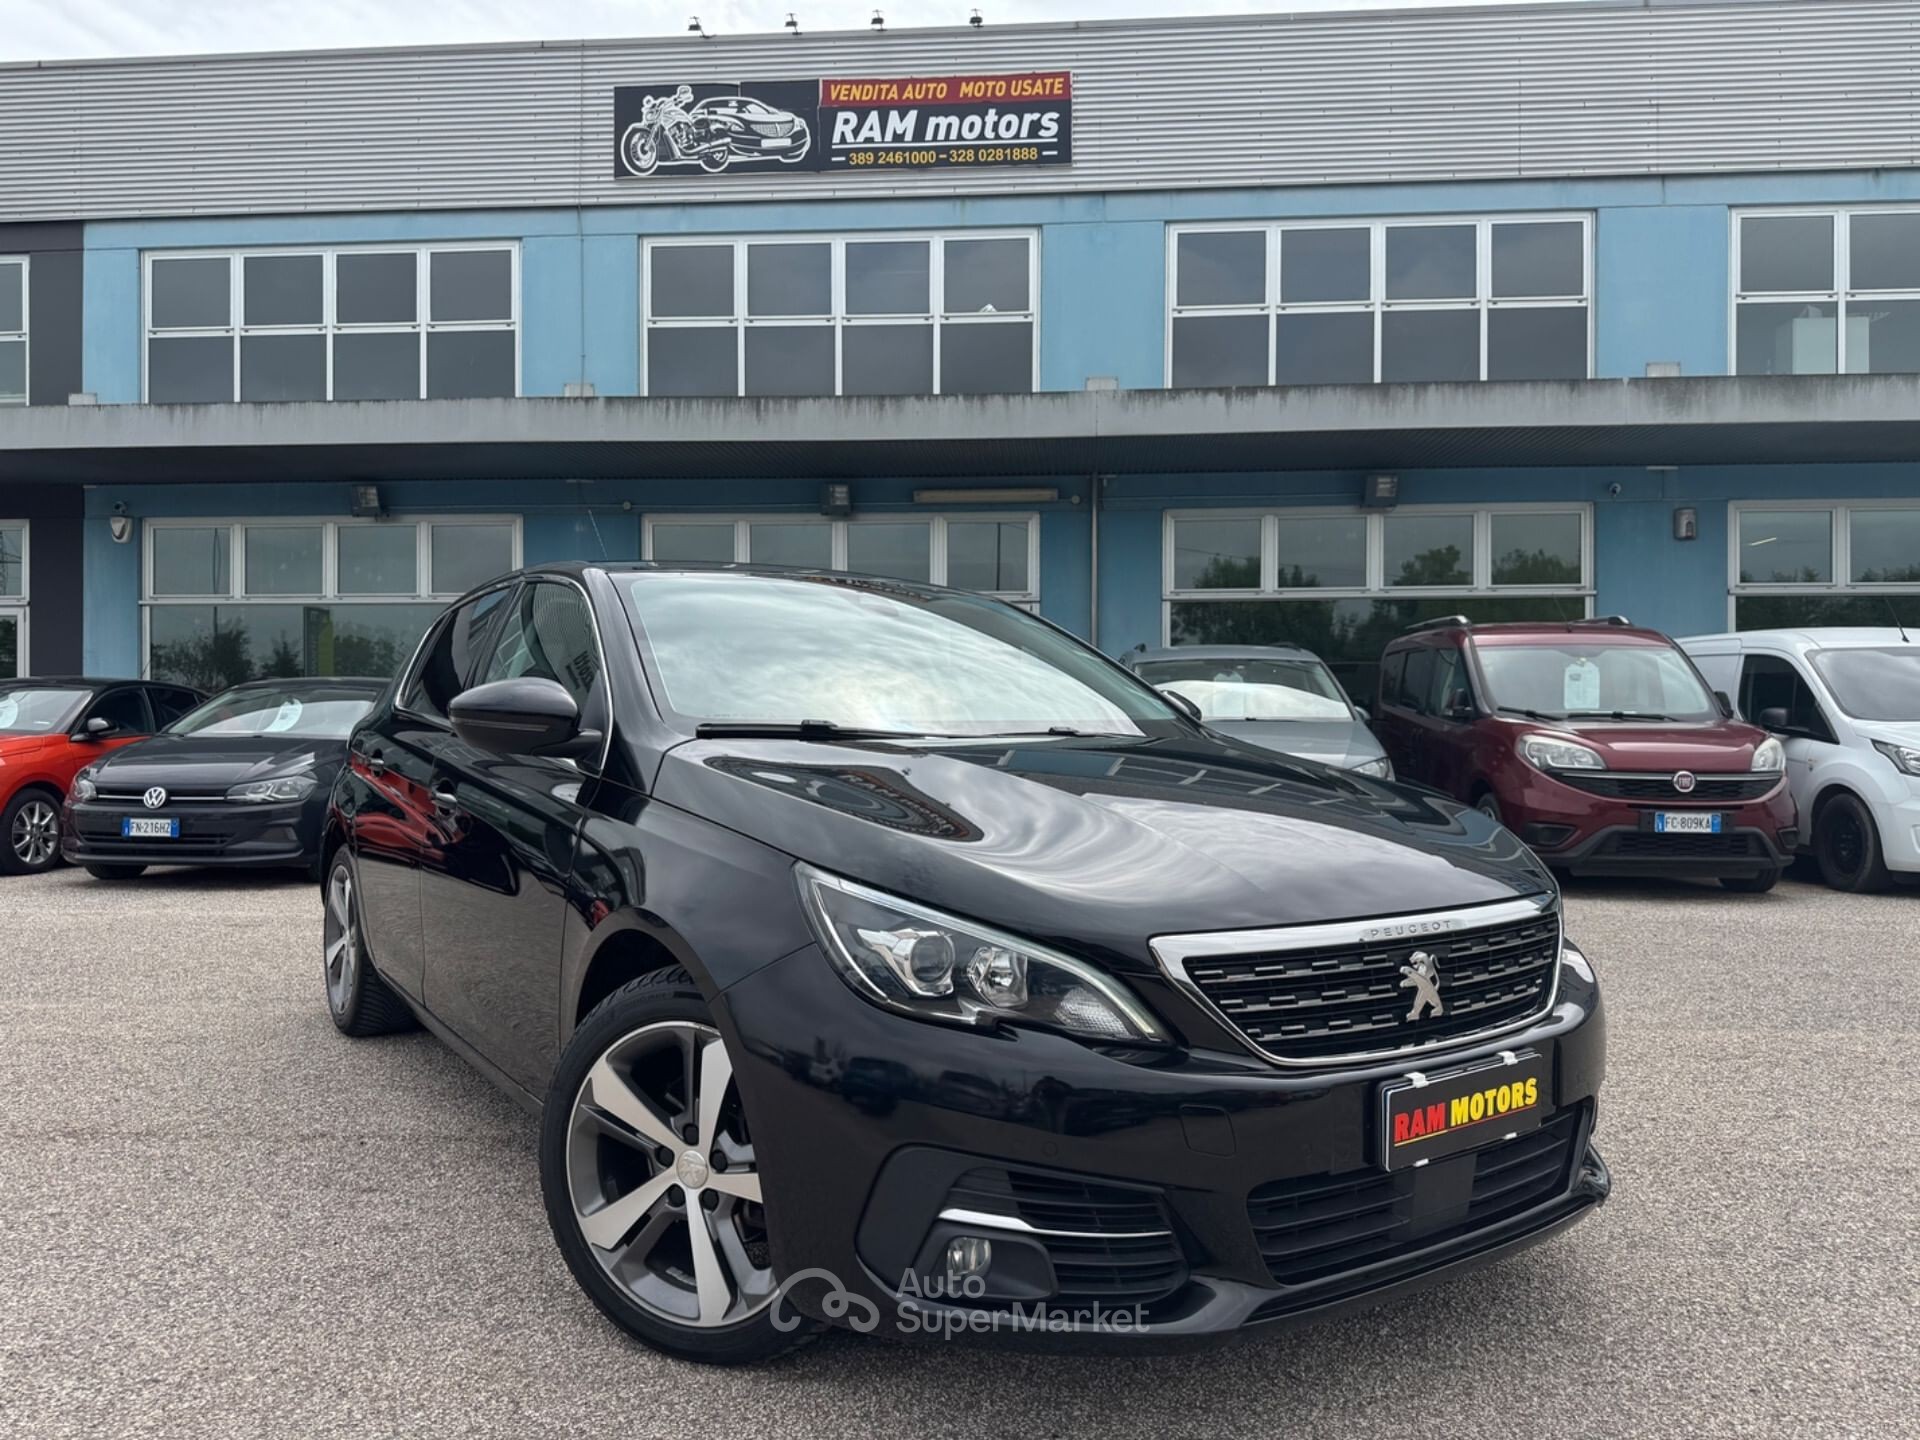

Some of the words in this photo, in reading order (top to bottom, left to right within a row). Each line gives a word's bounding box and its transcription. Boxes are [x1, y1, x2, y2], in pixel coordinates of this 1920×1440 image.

[830, 84, 899, 101] VENDITA
[902, 82, 948, 100] AUTO
[959, 80, 1007, 98] MOTO
[1010, 78, 1064, 96] USATE
[831, 109, 918, 144] RAM
[924, 108, 1060, 141] motors
[849, 151, 874, 165] 389
[878, 150, 936, 164] 2461000
[949, 149, 974, 162] 328
[978, 147, 1038, 161] 0281888
[1370, 919, 1451, 938] PEUGEOT
[1394, 1102, 1446, 1143] RAM
[1450, 1077, 1538, 1127] MOTORS
